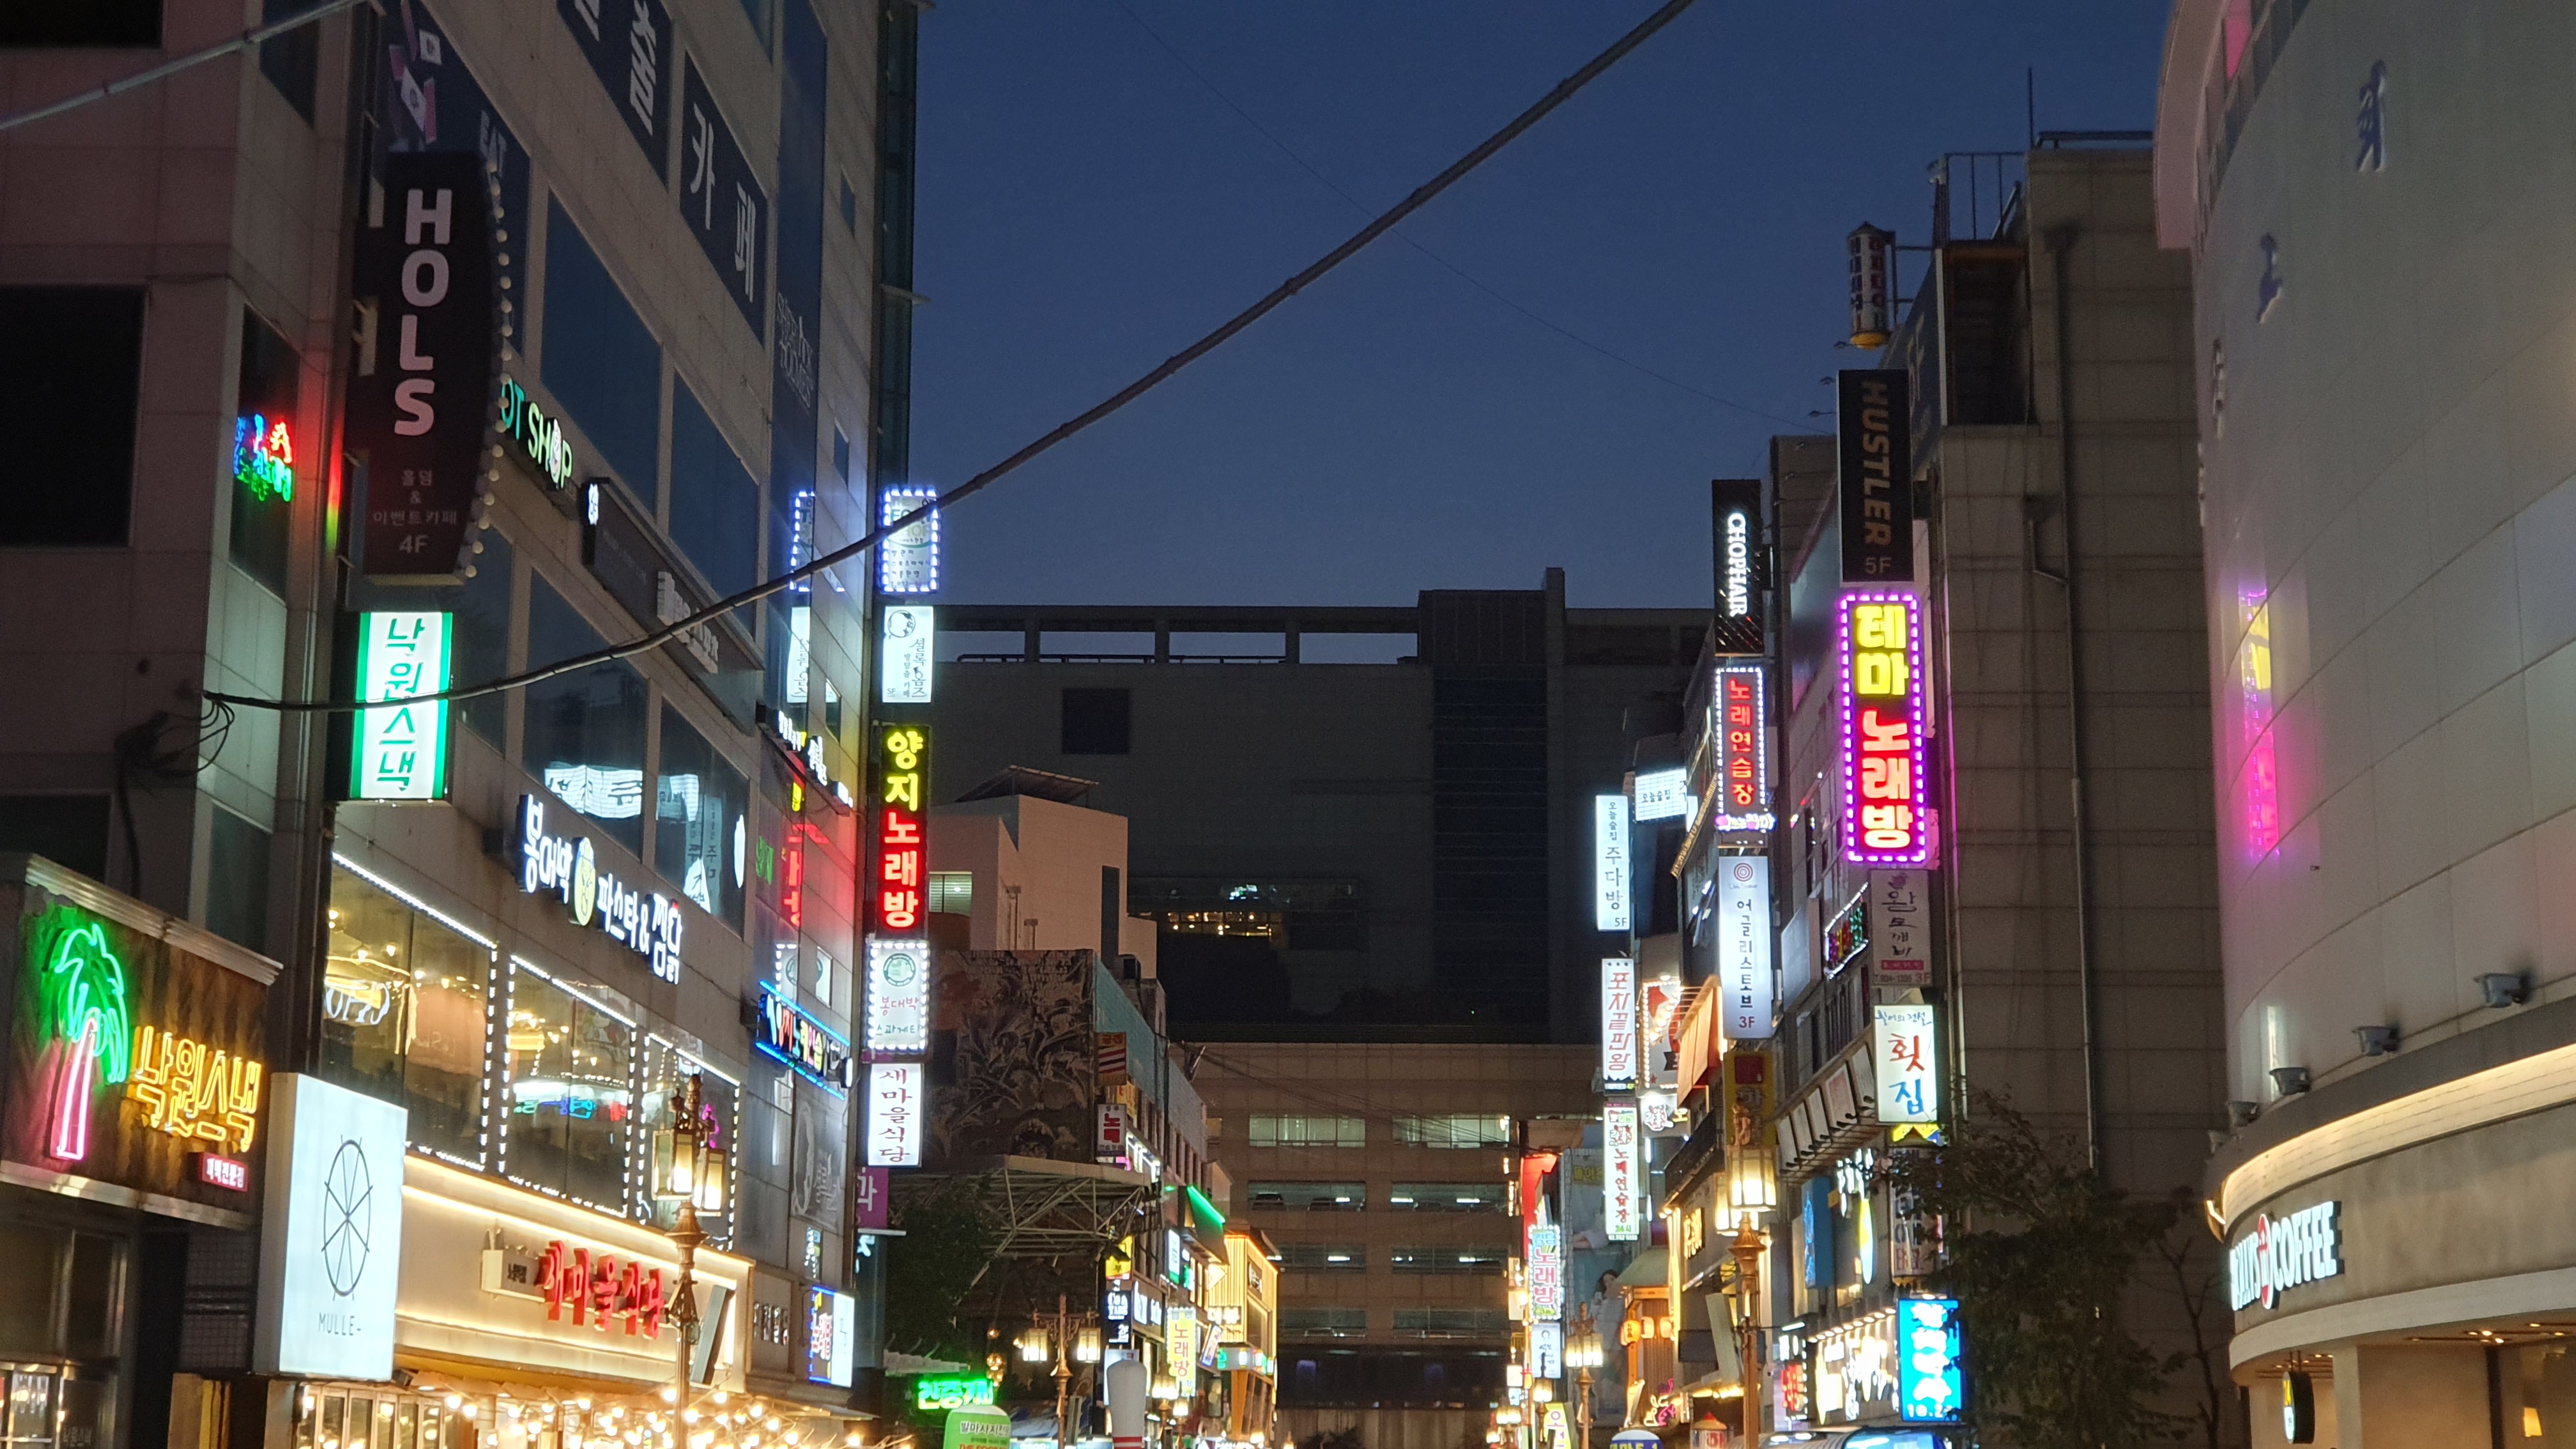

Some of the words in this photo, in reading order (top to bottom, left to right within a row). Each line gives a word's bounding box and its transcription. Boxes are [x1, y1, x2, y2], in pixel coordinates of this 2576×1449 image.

[394, 189, 452, 436] HOLS
[528, 402, 573, 489] SHOP
[1862, 386, 1889, 546] HUSTLER
[373, 510, 457, 526] 이벤트카페
[410, 491, 422, 503] &
[399, 534, 429, 553] 4F
[1865, 556, 1891, 574] 5F
[1857, 604, 1909, 696] 테마
[885, 730, 923, 812] 양지
[1729, 680, 1754, 805] 노래연습장
[1862, 709, 1913, 848] 노래방
[1607, 801, 1619, 841] 오늘술집
[1641, 788, 1671, 804] 오늘술집
[524, 793, 573, 904] 봉대박
[597, 873, 639, 949] 파스타
[639, 903, 650, 955] &
[884, 811, 920, 928] 노래방
[1604, 847, 1623, 910] 주다방
[1614, 917, 1627, 928] 5F
[1736, 898, 1754, 1009] 어글리스토브
[880, 996, 920, 1016] 봉대박
[1608, 971, 1632, 1073] 포차끝판왕
[1738, 1016, 1755, 1029] 3F
[134, 1025, 262, 1153] 낙원스낵
[878, 1068, 914, 1163] 새마을식당
[1889, 1033, 1926, 1116] 횟집
[1533, 1248, 1557, 1305] 노래방
[2271, 1200, 2338, 1292] COFFEE
[538, 1239, 665, 1340] 새마을식당
[1174, 1324, 1190, 1377] 노래방
